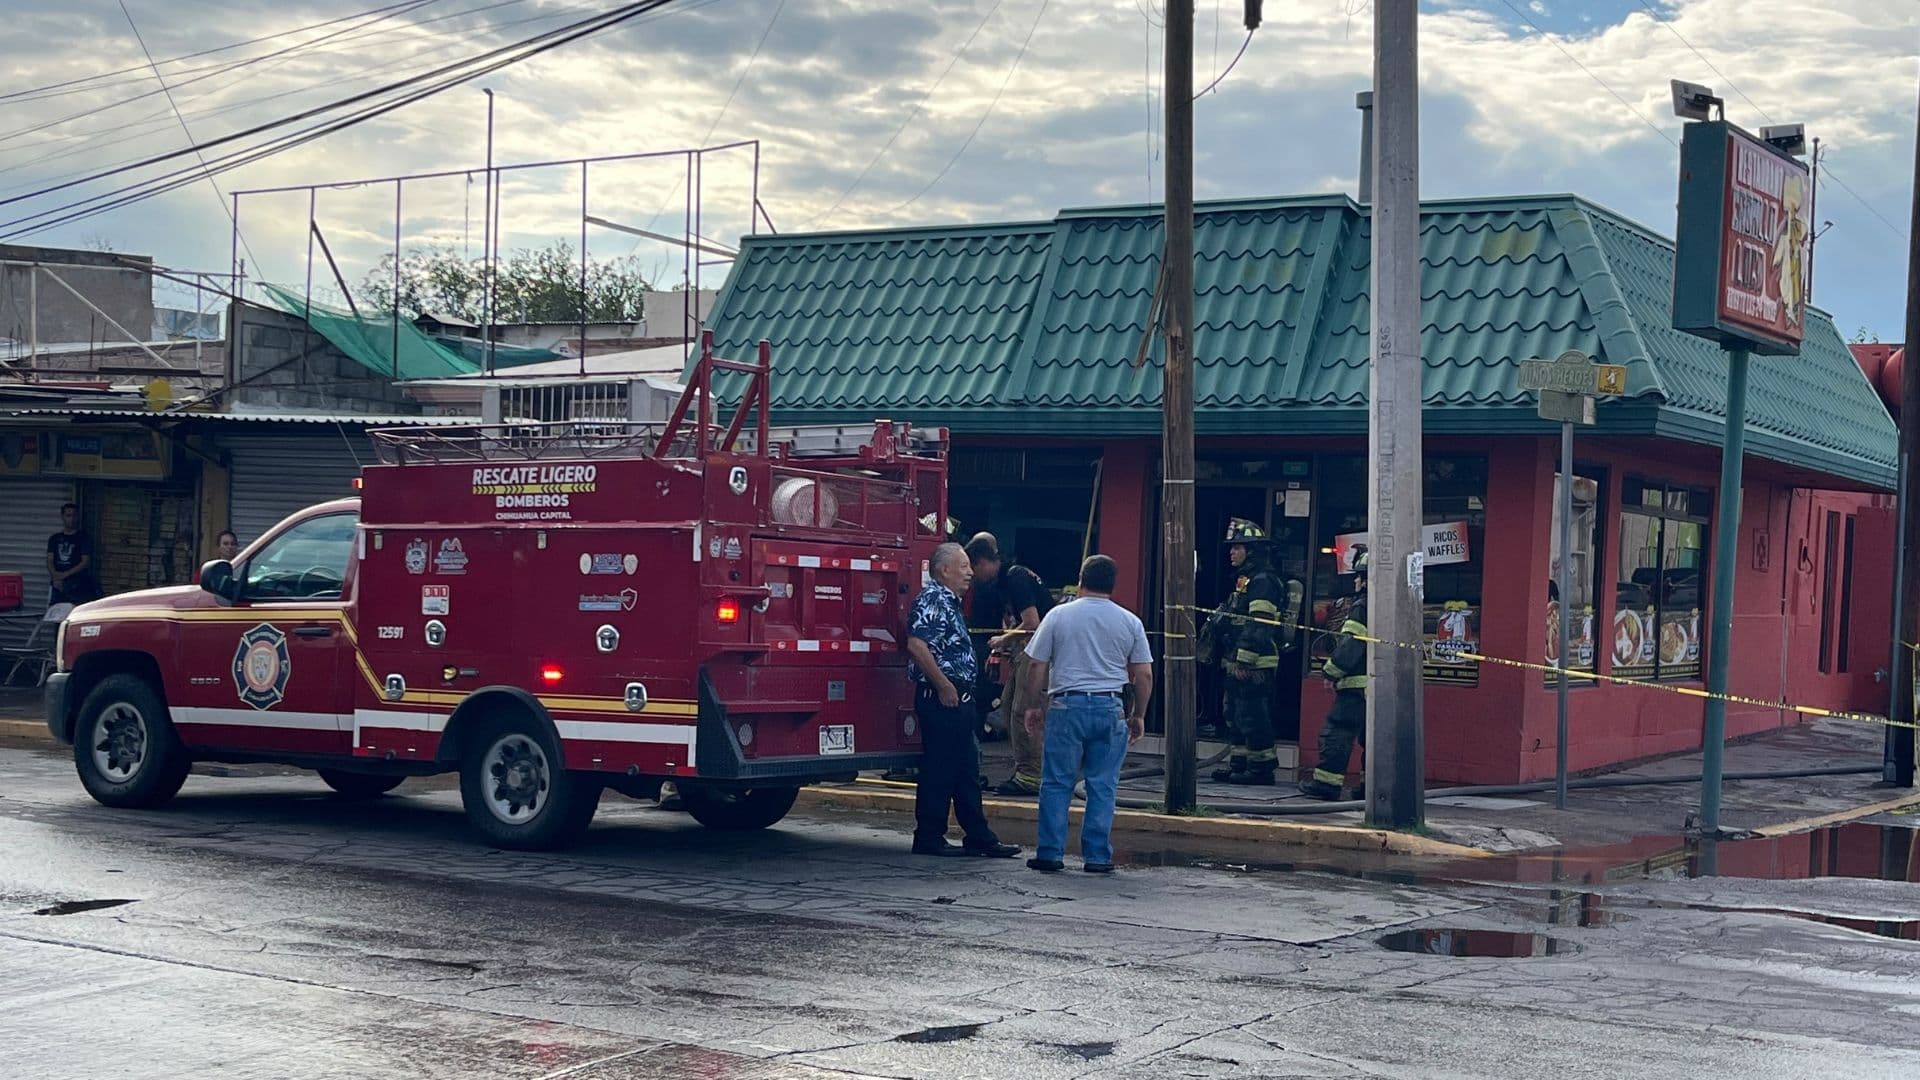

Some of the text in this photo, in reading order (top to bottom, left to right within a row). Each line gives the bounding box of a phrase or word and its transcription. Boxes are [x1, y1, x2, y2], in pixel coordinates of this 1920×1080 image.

[473, 465, 597, 485] RESCATE LIGERO
[495, 494, 569, 508] BOMBEROS
[495, 511, 572, 520] CHIHUAHUA CAPITAL
[1433, 530, 1458, 543] RICOS
[1427, 543, 1465, 557] WAFFLES
[377, 626, 405, 639] 12591
